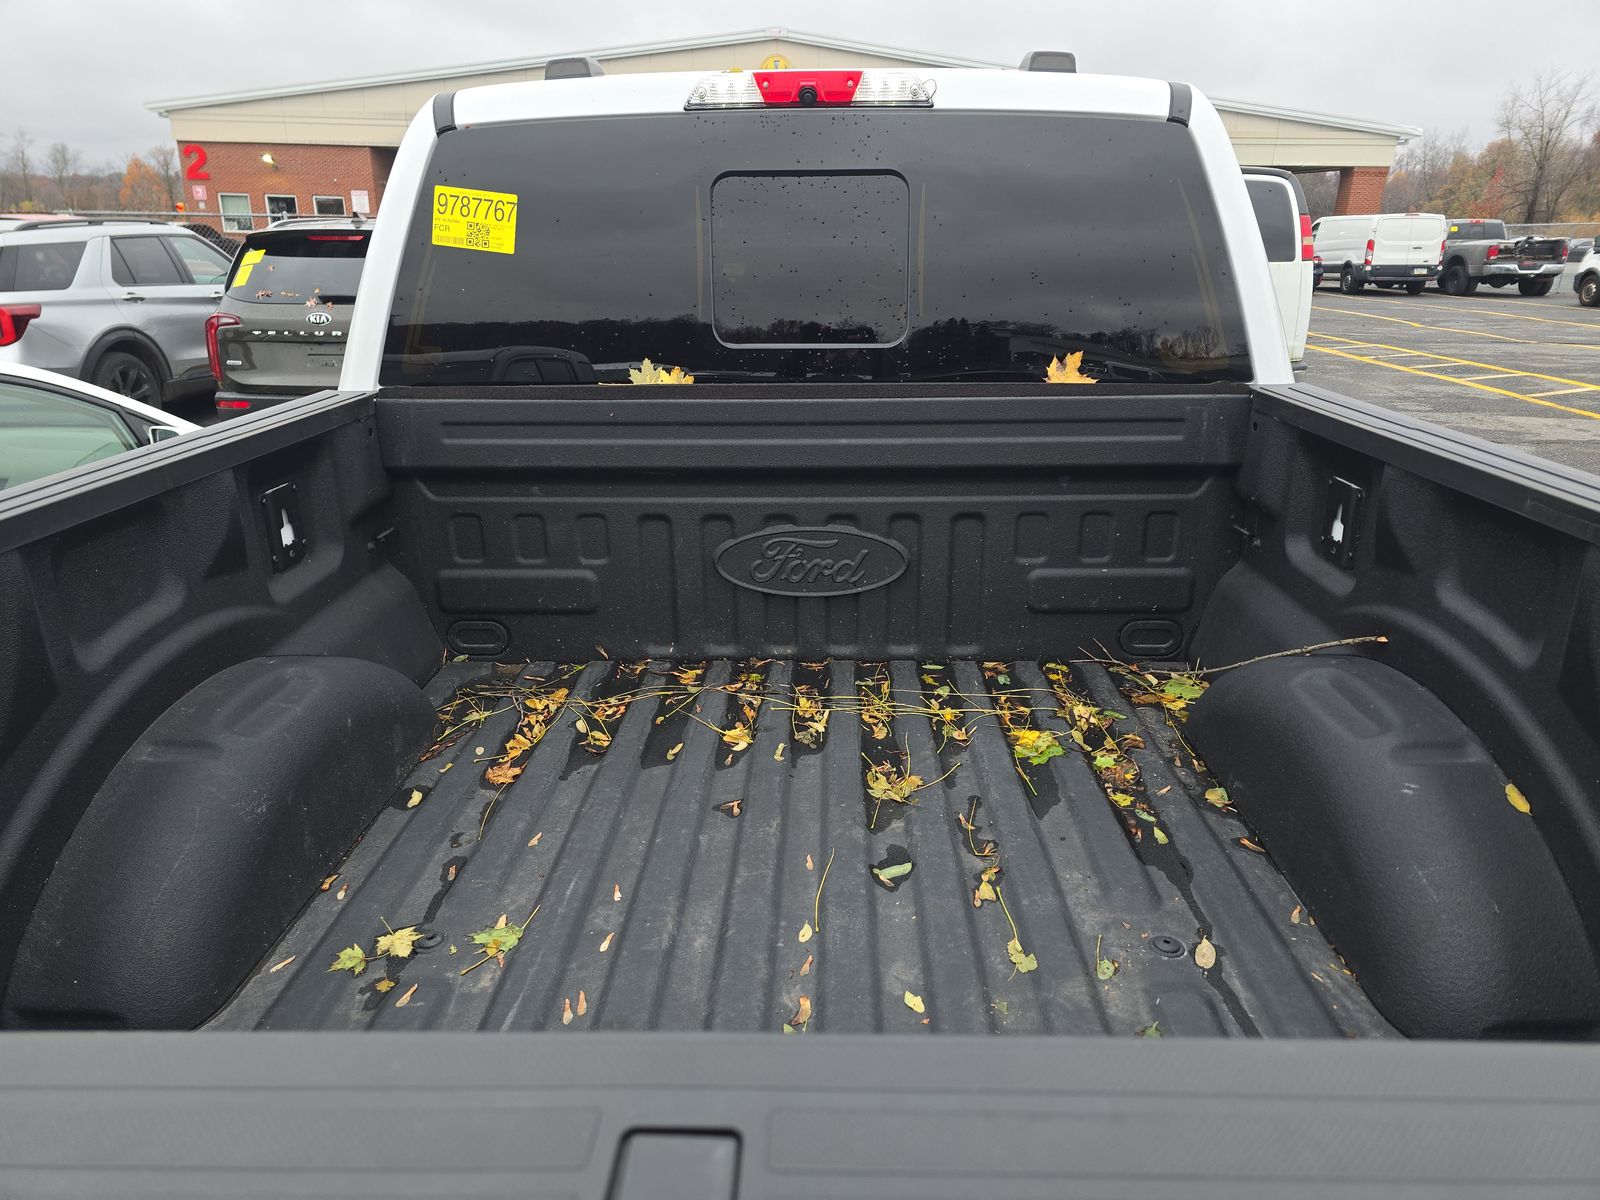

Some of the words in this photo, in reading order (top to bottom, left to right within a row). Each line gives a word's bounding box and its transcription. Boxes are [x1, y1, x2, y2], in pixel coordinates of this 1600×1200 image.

[183, 144, 210, 180] 2
[437, 193, 517, 222] 9787767
[309, 314, 328, 323] KIA
[750, 537, 868, 583] Ford
